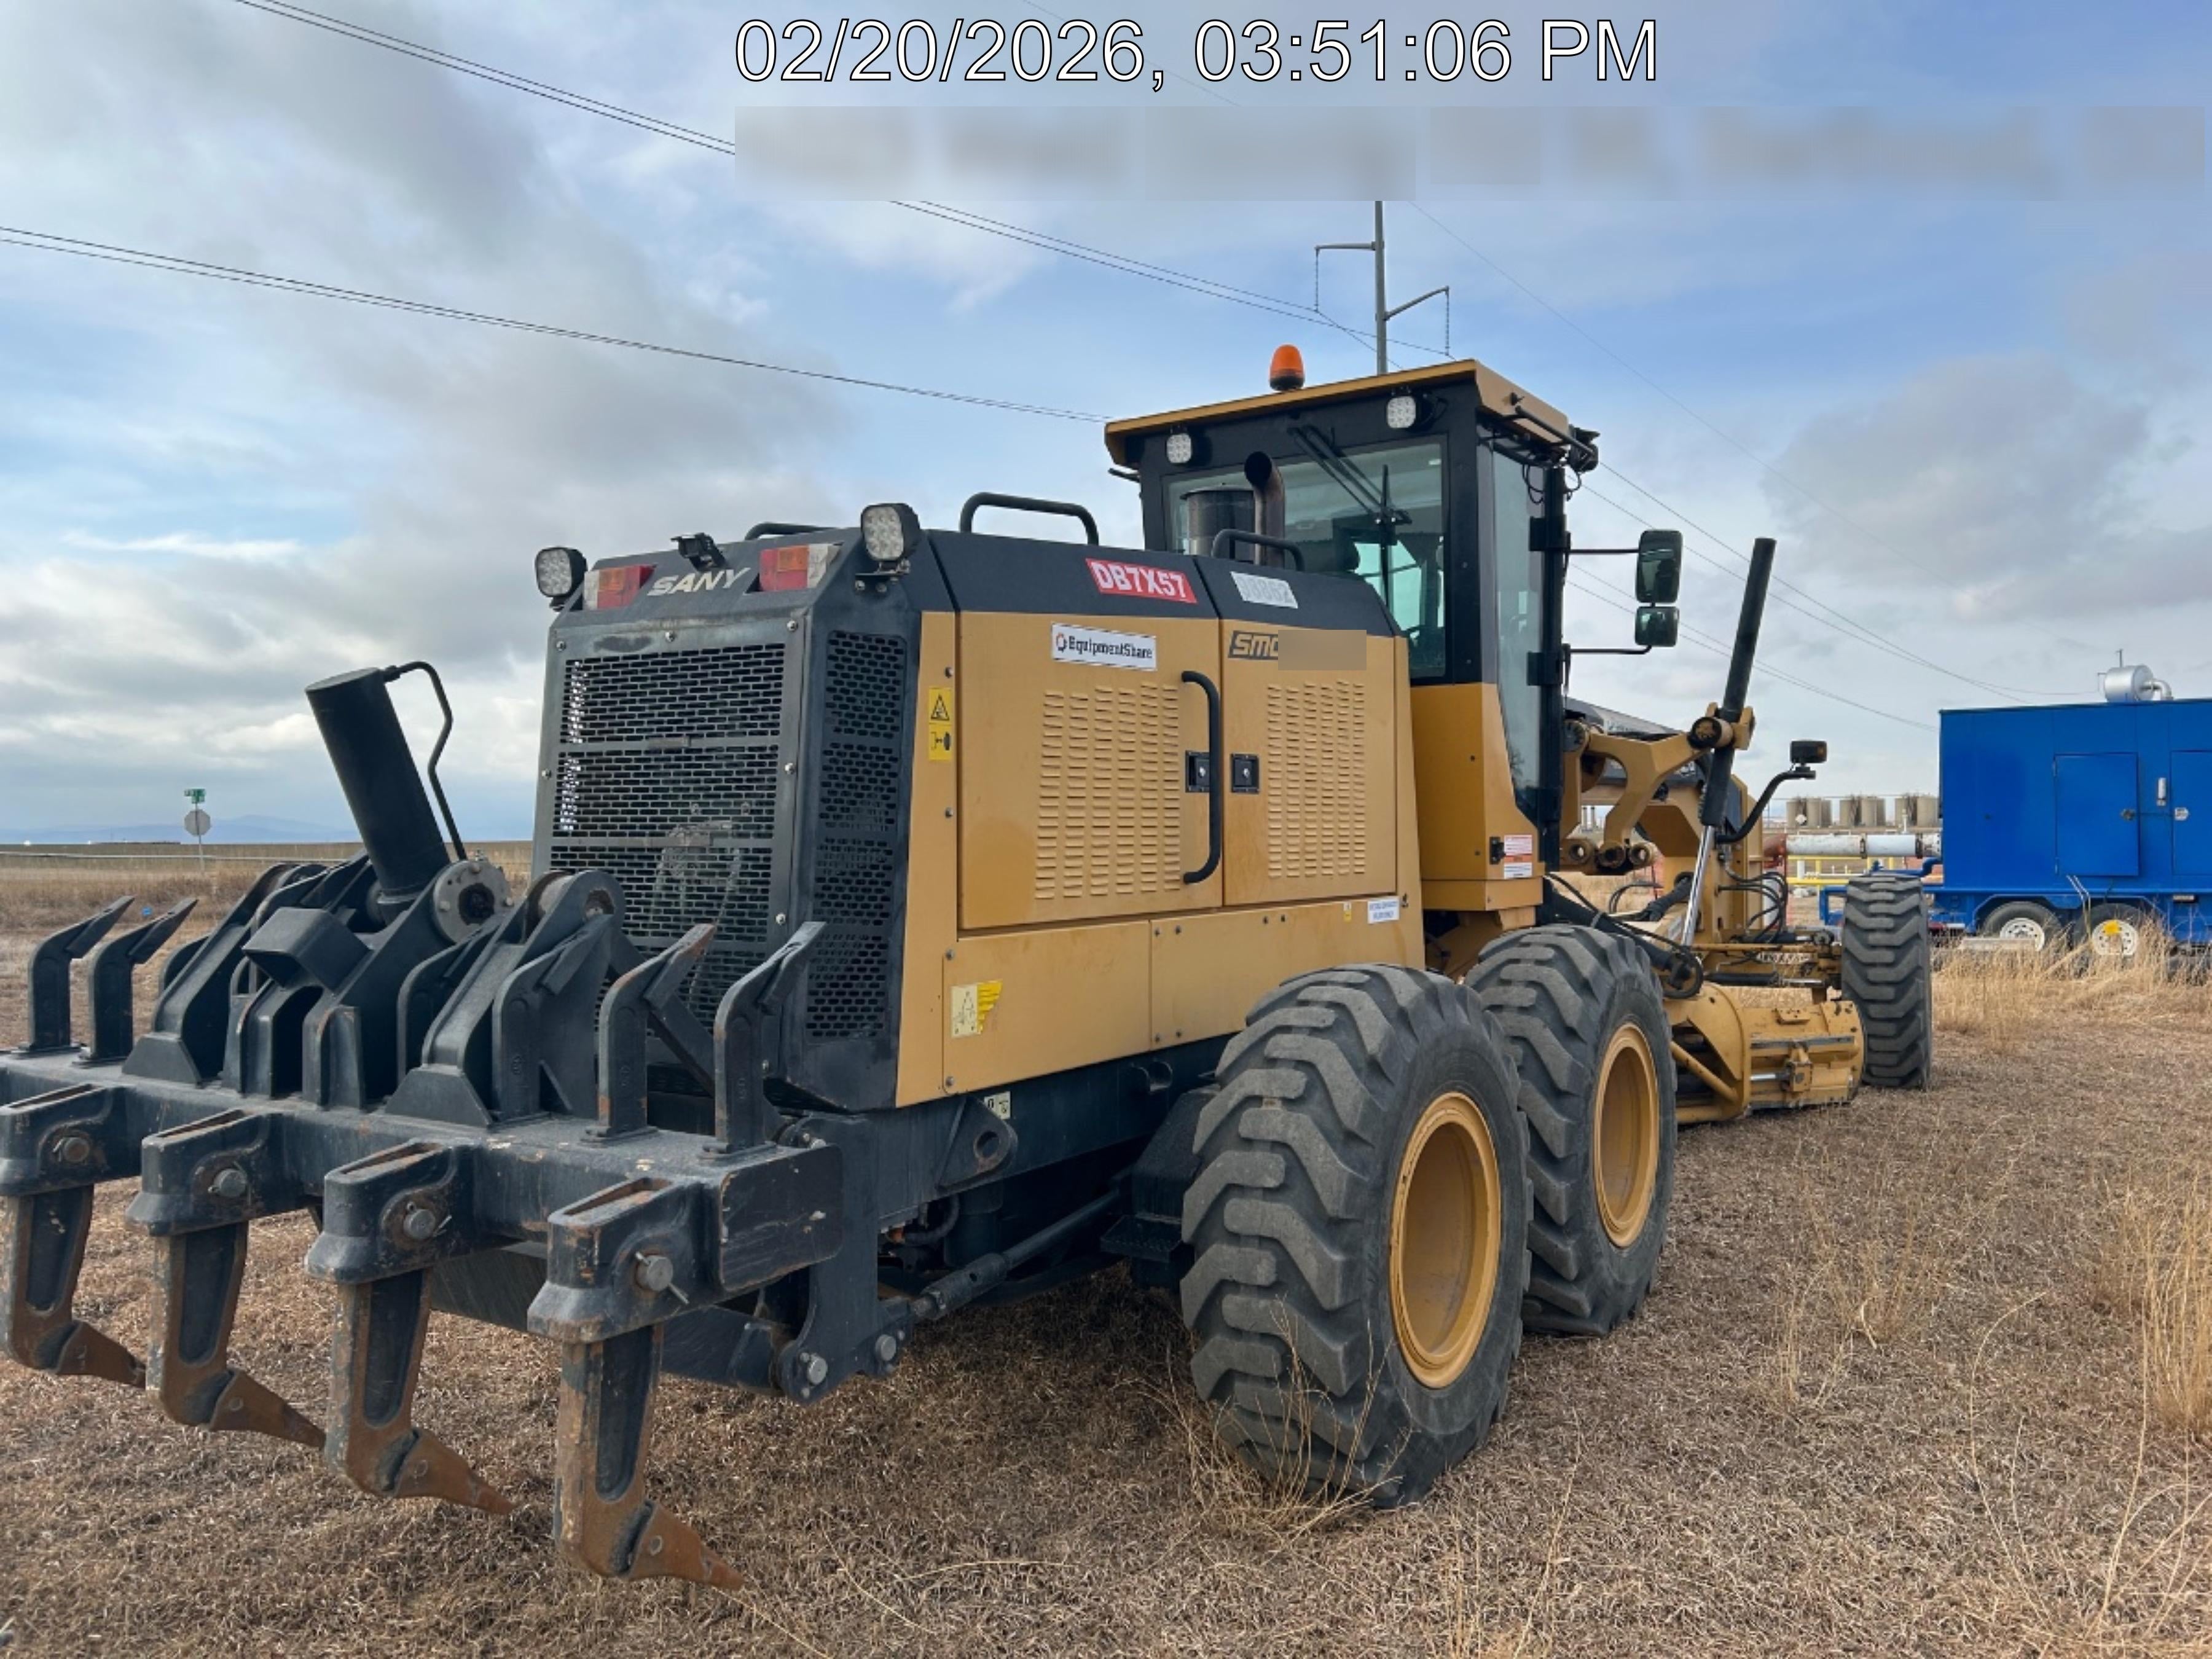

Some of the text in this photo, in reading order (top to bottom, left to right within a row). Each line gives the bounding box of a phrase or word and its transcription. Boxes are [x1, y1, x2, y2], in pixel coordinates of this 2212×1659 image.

[647, 567, 751, 596] SANY
[1091, 562, 1186, 598] DB7X57
[1068, 635, 1153, 659] EquipmentShare
